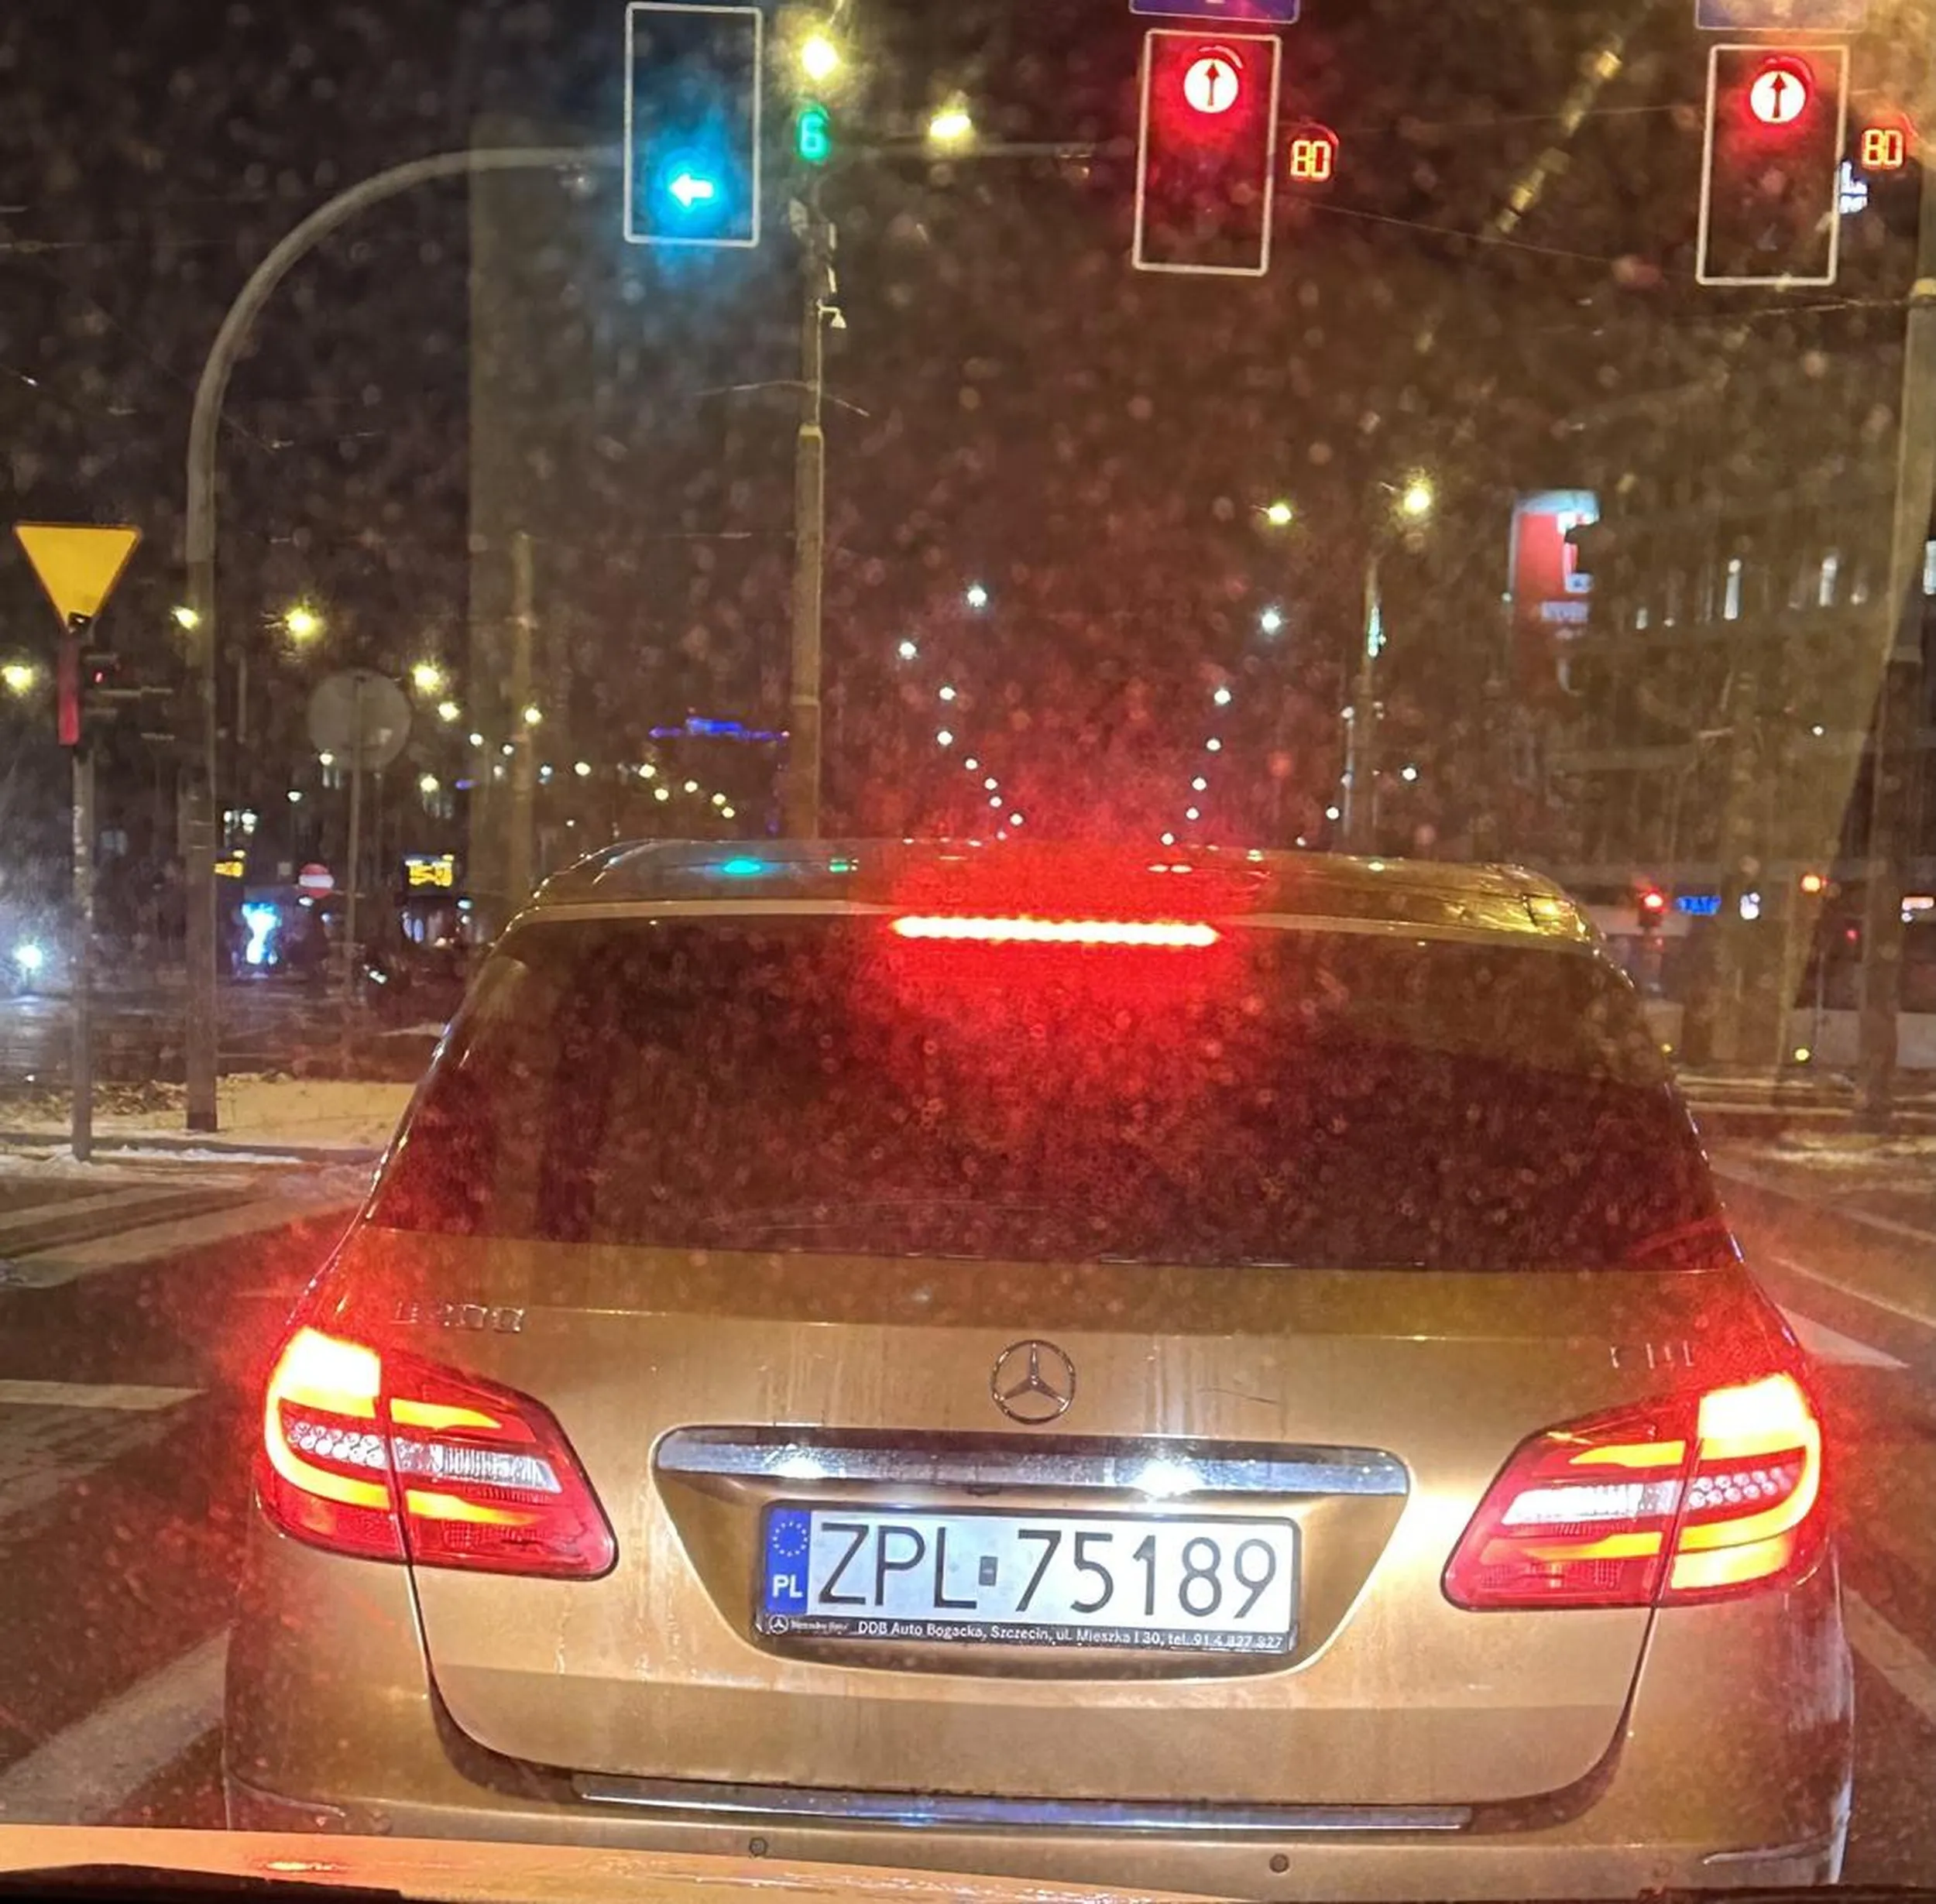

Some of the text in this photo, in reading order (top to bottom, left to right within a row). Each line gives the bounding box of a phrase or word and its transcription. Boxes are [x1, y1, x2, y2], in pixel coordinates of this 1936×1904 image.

[1290, 139, 1332, 181] 80
[1862, 129, 1903, 169] 80
[772, 1574, 803, 1598] PL
[819, 1522, 1277, 1619] ZPL 75189
[857, 1620, 887, 1635] DDB
[891, 1621, 923, 1636] Auto
[991, 1624, 1053, 1642] Szczecin,
[1142, 1631, 1165, 1646] 30,
